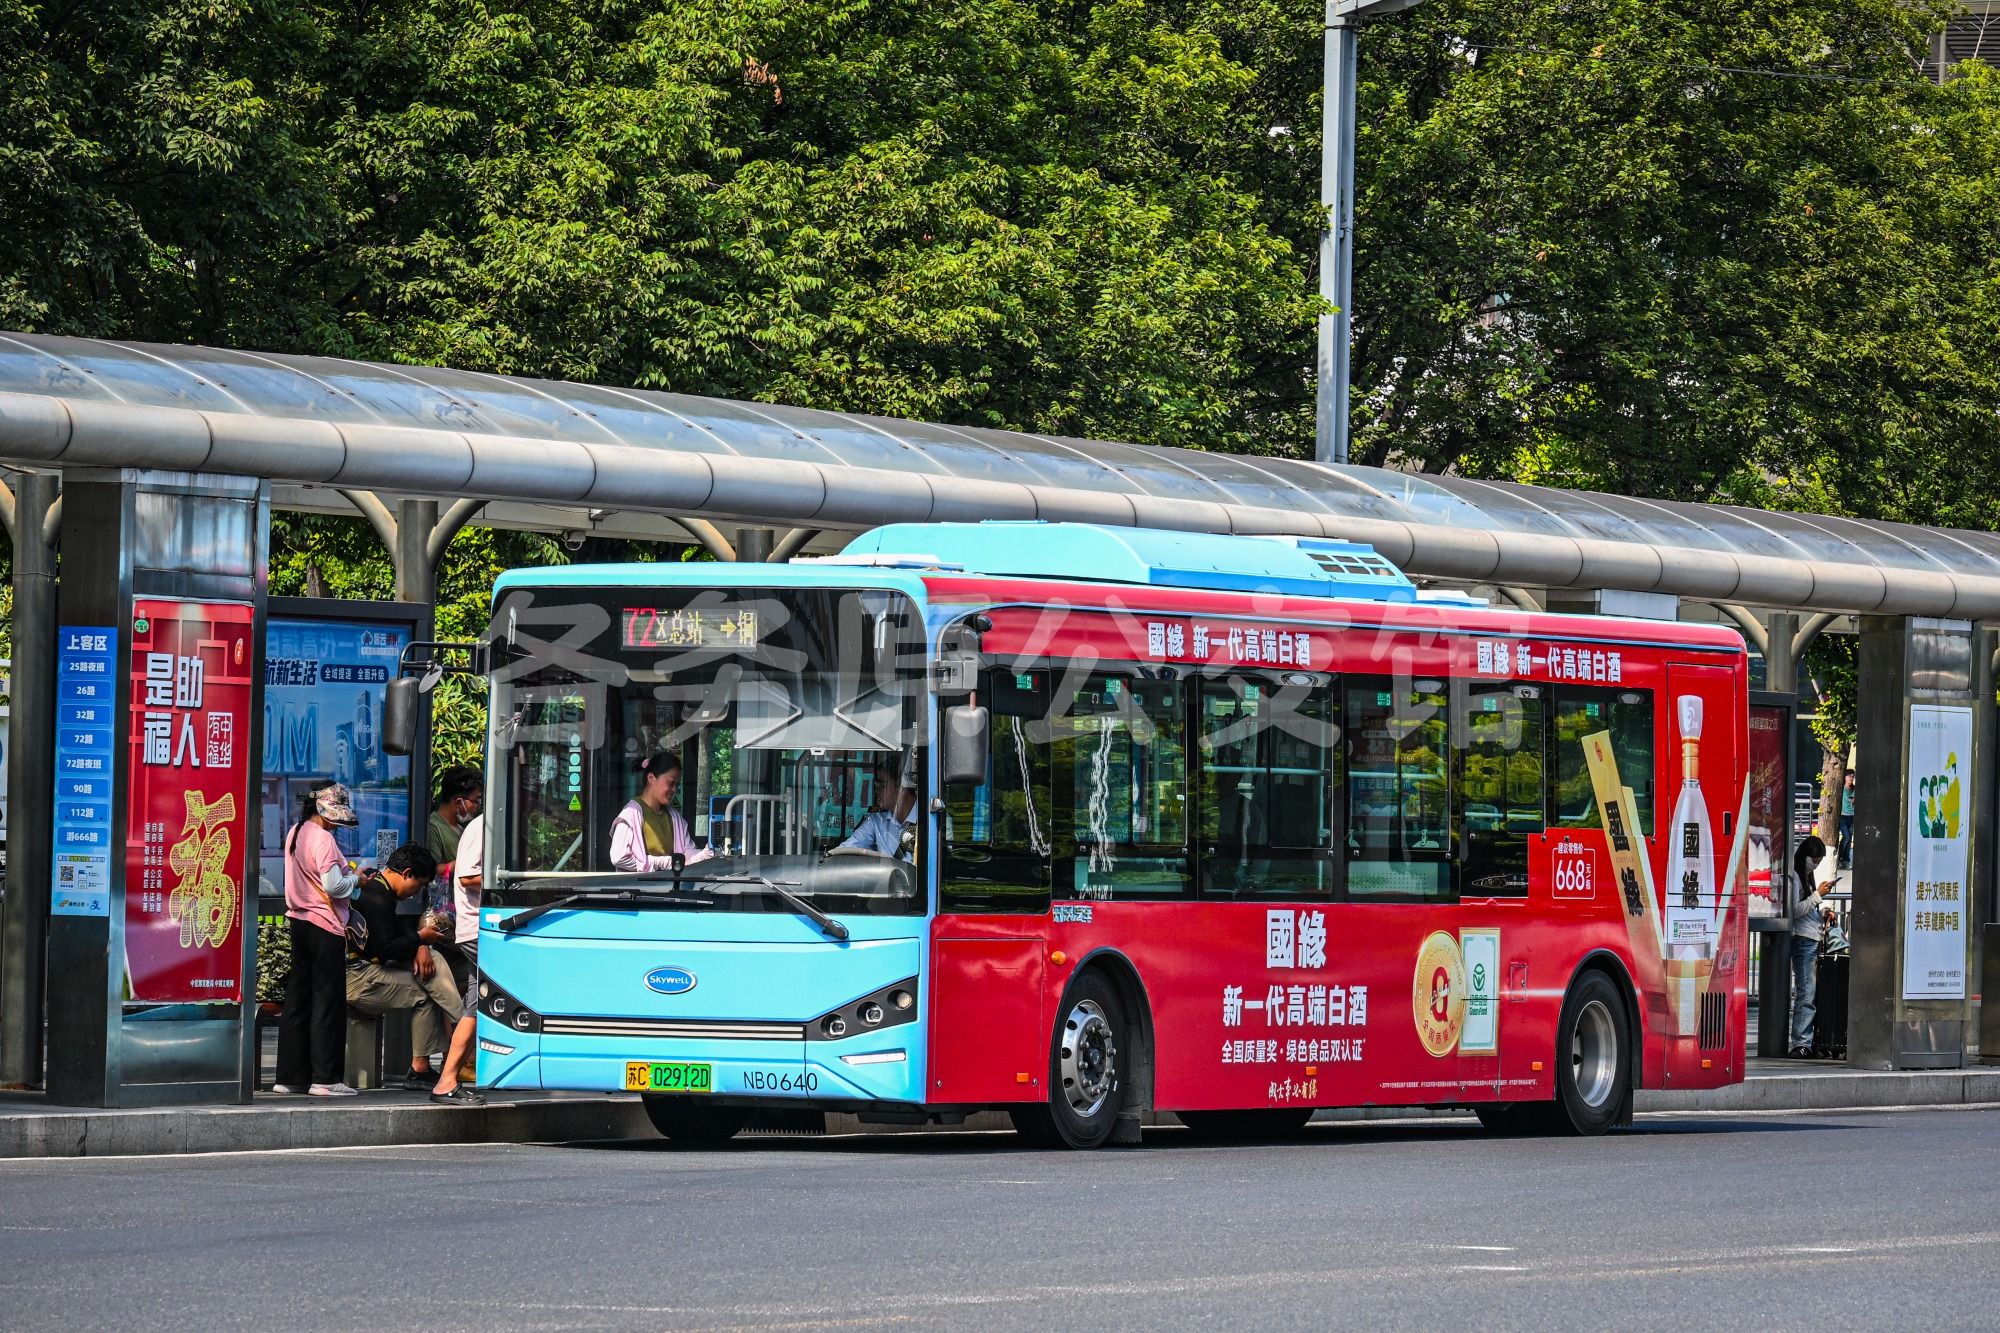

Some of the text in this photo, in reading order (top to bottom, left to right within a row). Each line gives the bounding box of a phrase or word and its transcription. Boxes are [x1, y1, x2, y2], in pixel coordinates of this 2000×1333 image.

[67, 635, 108, 651] 上客区
[1193, 625, 1311, 666] 新一代高端白酒
[69, 662, 105, 672] 25路夜班
[1517, 644, 1621, 682] 新一代高端白酒
[324, 667, 352, 680] 全域提速
[357, 668, 385, 681] 全面升级
[76, 686, 96, 696] 26路
[76, 710, 95, 720] 32路
[74, 734, 93, 745] 72路
[66, 759, 102, 769] 72路夜班
[73, 784, 93, 794] 90路
[70, 808, 95, 818] 112路
[66, 832, 98, 843] 游666路
[1558, 842, 1584, 854] 建议零售价
[1556, 860, 1585, 890] 668
[1916, 880, 1959, 901] 提升文明素质
[1915, 910, 1959, 932] 共享健康中国
[1223, 985, 1368, 1026] 新一代高端白酒
[743, 1071, 818, 1091] NB0640
